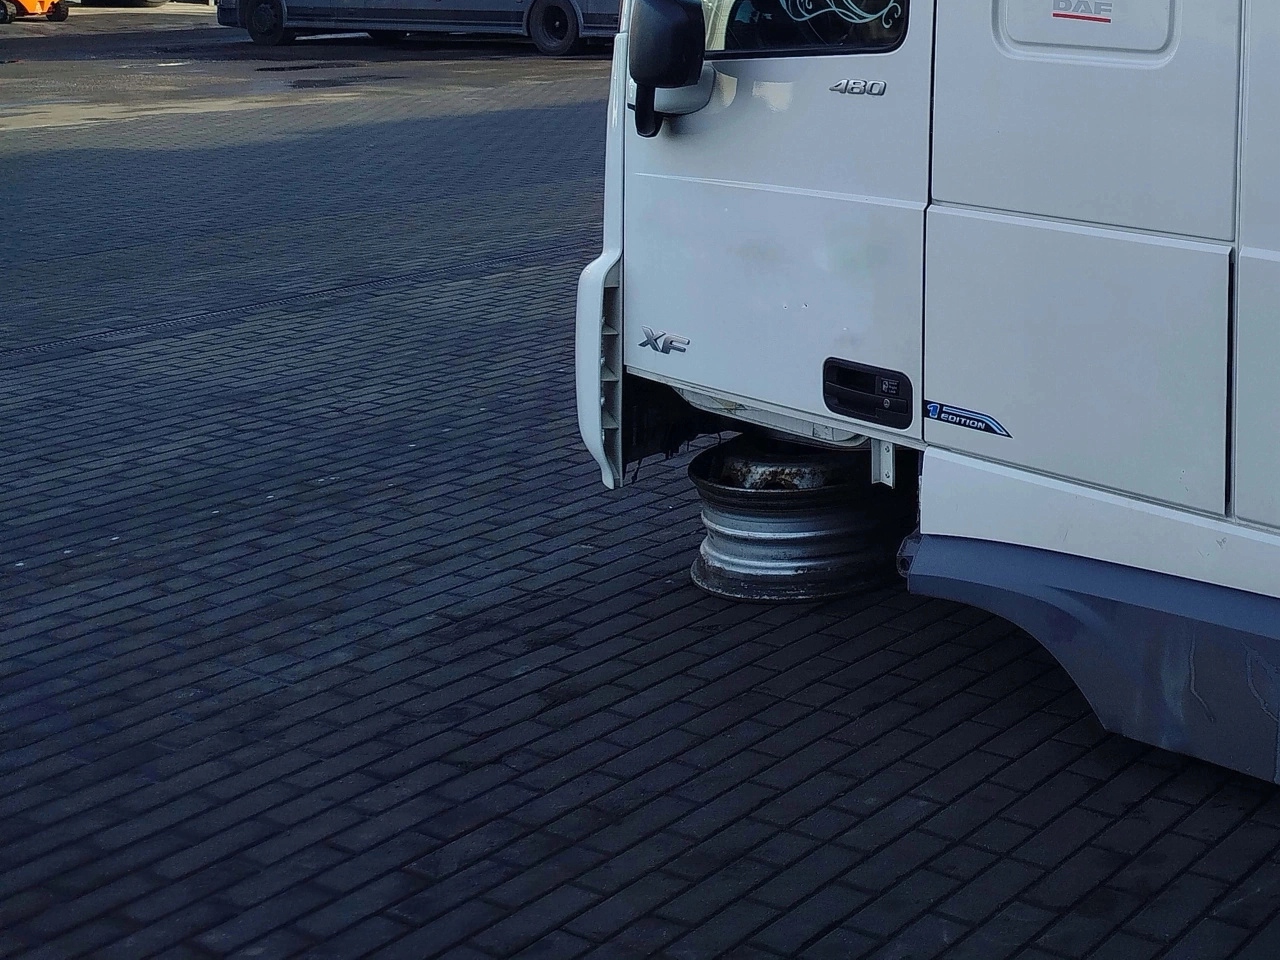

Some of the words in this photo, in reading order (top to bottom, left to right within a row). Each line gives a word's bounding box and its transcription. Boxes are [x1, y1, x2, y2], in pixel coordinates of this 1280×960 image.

[828, 79, 887, 96] 480
[637, 325, 691, 355] XF
[927, 403, 940, 419] 1
